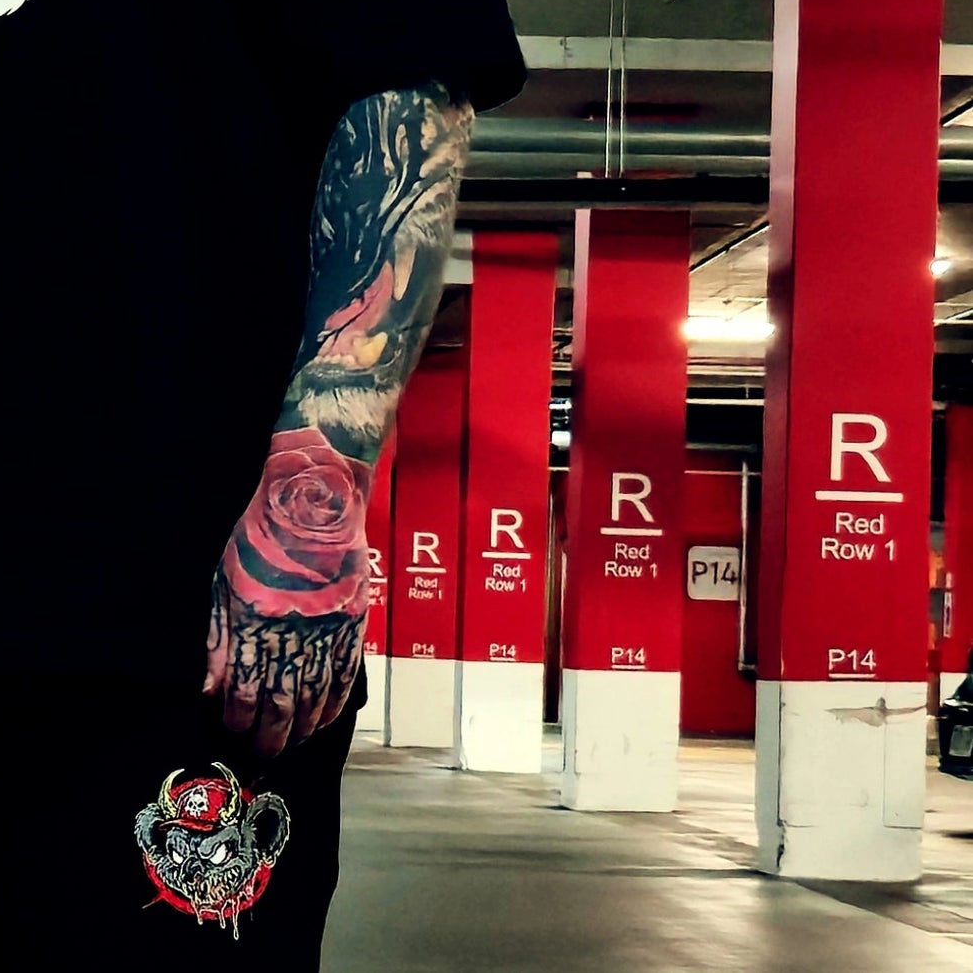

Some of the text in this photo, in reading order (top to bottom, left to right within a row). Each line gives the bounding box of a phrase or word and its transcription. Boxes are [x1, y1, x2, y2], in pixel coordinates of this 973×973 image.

[830, 413, 892, 483] R
[611, 472, 655, 523] R
[490, 508, 524, 548] R
[835, 512, 885, 535] Red
[412, 531, 441, 565] R
[615, 542, 651, 560] Red
[821, 537, 896, 561] Row 1
[493, 563, 521, 578] Red
[604, 561, 658, 579] Row 1
[691, 561, 738, 585] P14
[414, 576, 438, 589] Red
[485, 577, 527, 592] Row 1
[408, 588, 443, 601] Row 1
[412, 643, 435, 654] P14
[489, 643, 517, 657] P14
[611, 647, 647, 664] P14
[828, 648, 877, 671] P14
